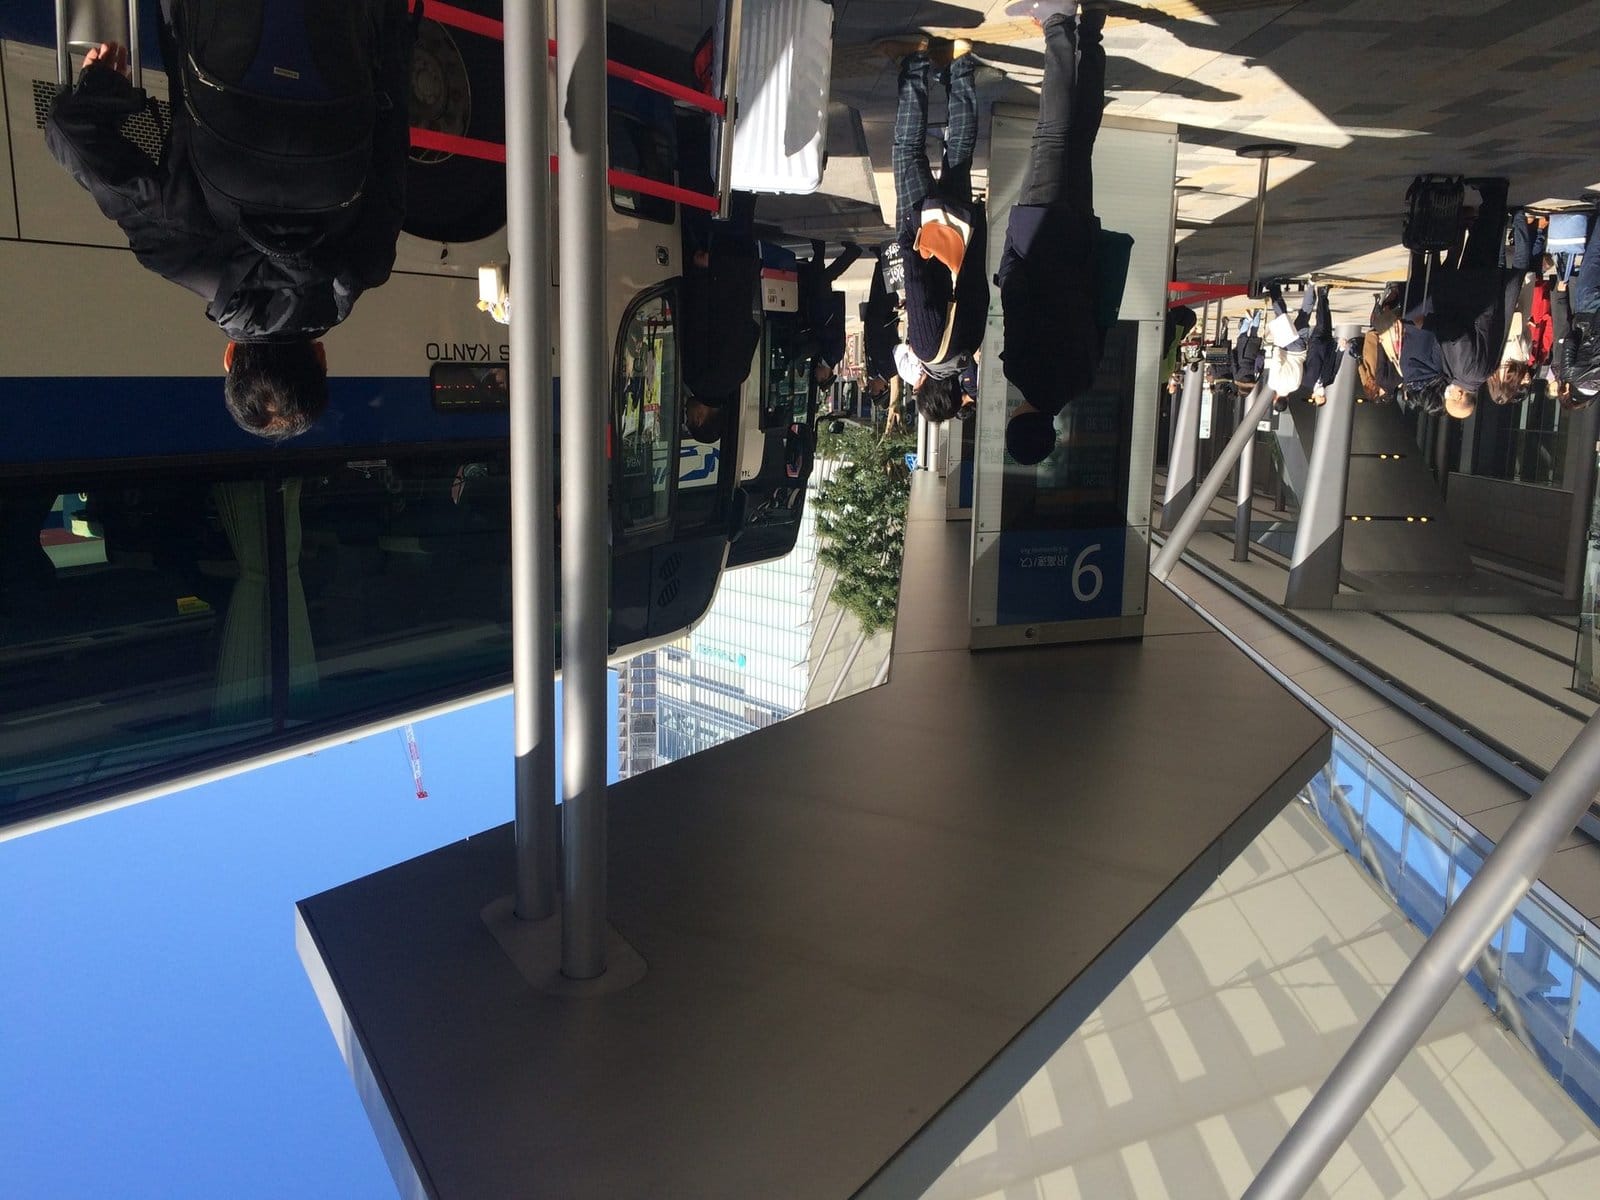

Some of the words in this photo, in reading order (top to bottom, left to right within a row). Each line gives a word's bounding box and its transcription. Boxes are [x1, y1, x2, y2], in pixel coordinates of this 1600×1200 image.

[426, 343, 490, 361] KANTO
[1019, 554, 1069, 568] JR高速バス
[1071, 543, 1103, 602] 9
